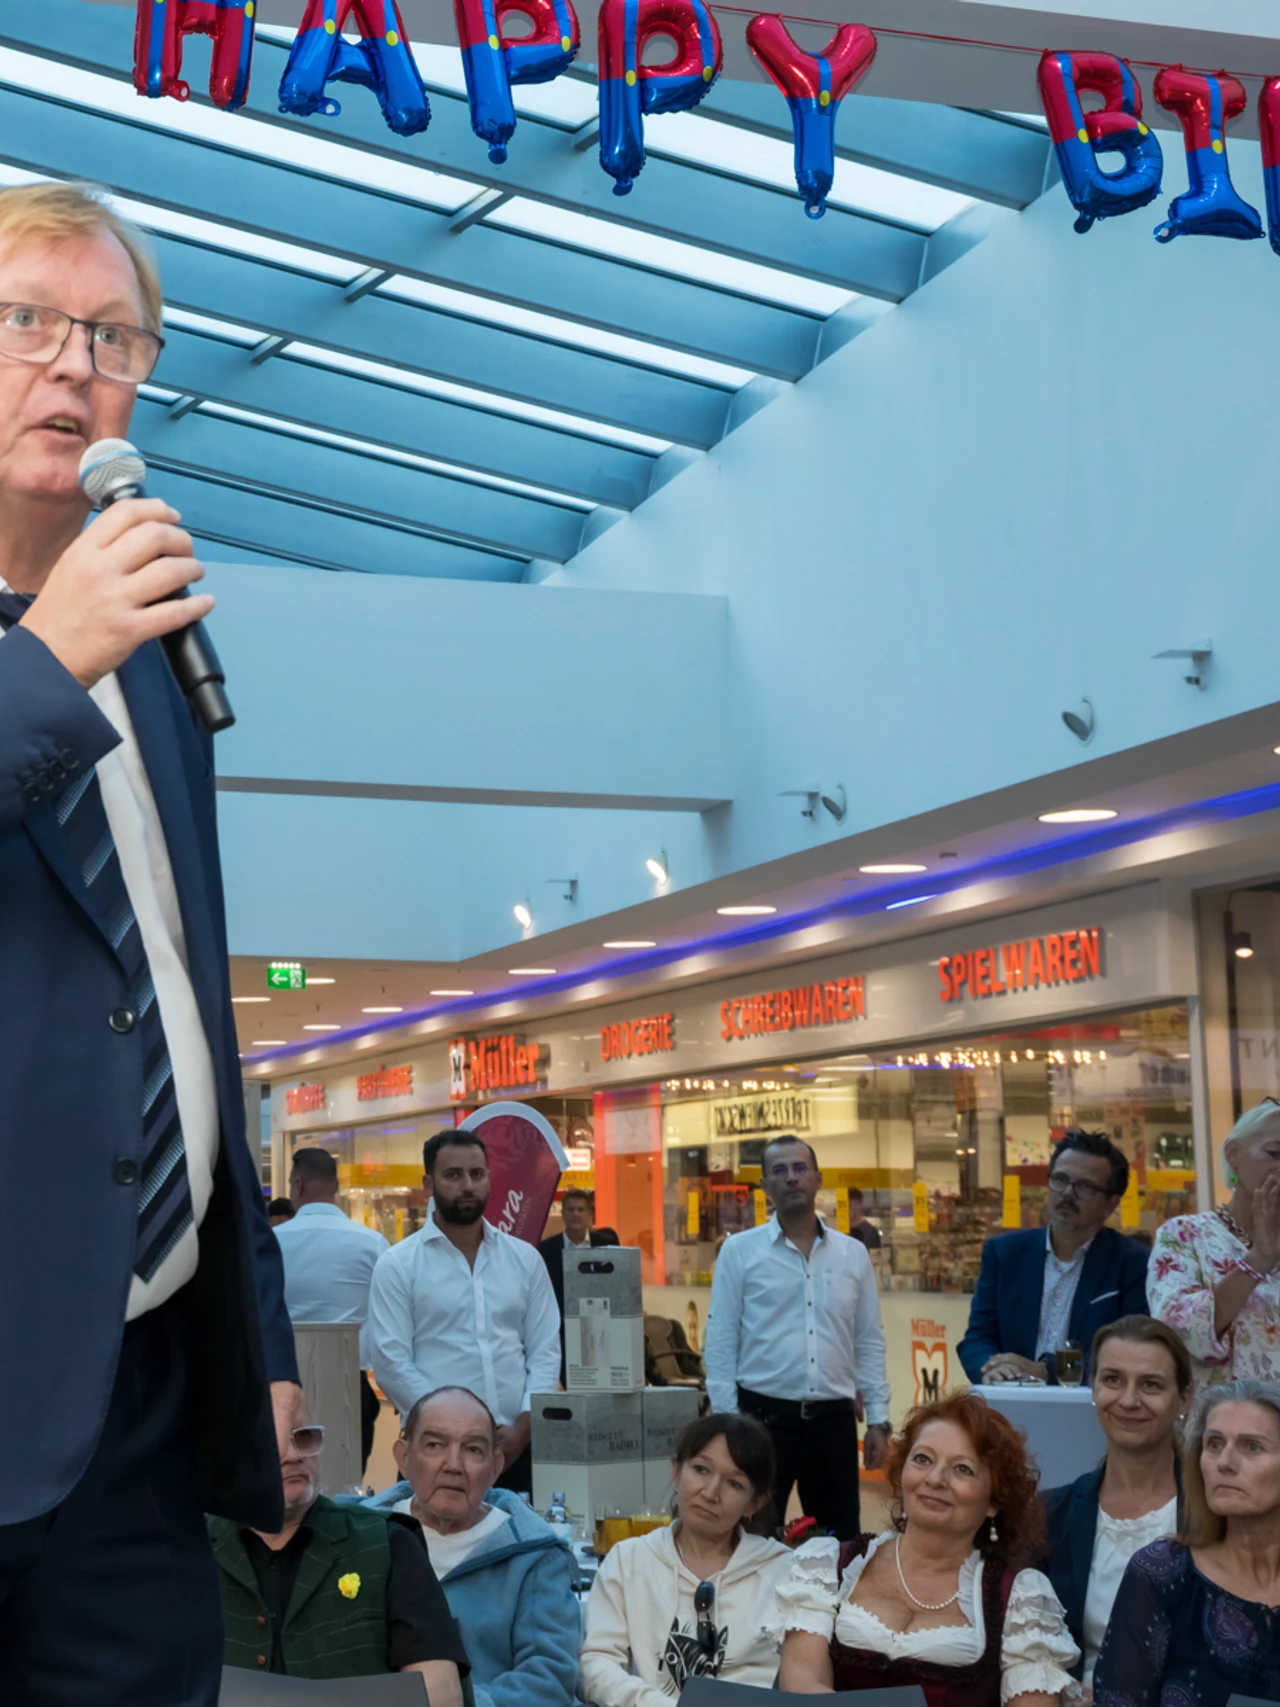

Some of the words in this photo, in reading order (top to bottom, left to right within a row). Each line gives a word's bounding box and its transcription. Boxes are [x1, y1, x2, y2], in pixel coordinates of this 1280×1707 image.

[133, 0, 877, 217] HAPPY
[1037, 48, 1280, 256] BI
[938, 926, 1099, 1002] SPIELWAREN
[600, 1012, 673, 1061] DROGERIE
[720, 975, 864, 1040] SCHREIBWAREN
[469, 1034, 541, 1092] Müller
[497, 1189, 523, 1234] ara
[910, 1317, 946, 1338] Müller
